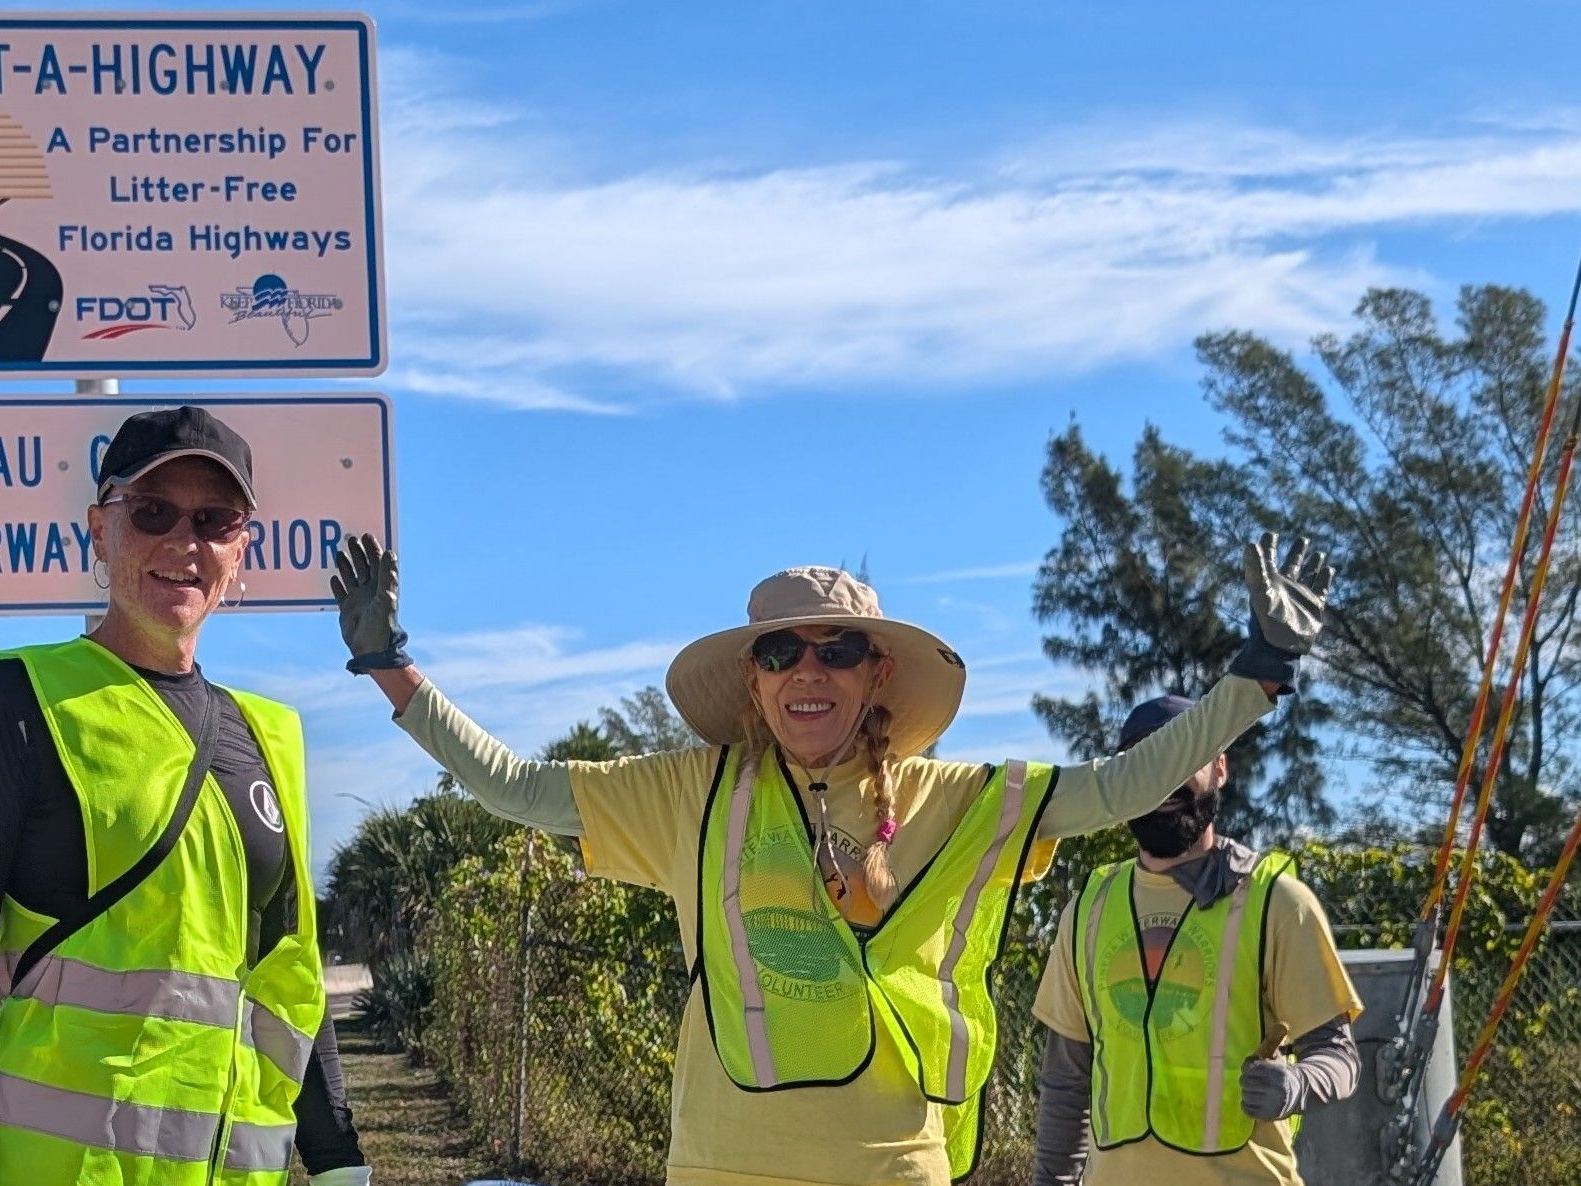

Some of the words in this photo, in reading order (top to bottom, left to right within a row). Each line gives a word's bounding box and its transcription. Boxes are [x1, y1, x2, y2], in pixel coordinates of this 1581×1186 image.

[47, 127, 71, 153] A
[89, 126, 286, 159] Partnership
[303, 127, 357, 153] For
[110, 176, 297, 202] Litter-Free
[59, 226, 173, 251] Florida
[190, 225, 352, 258] Highways
[76, 297, 176, 321] FDOT
